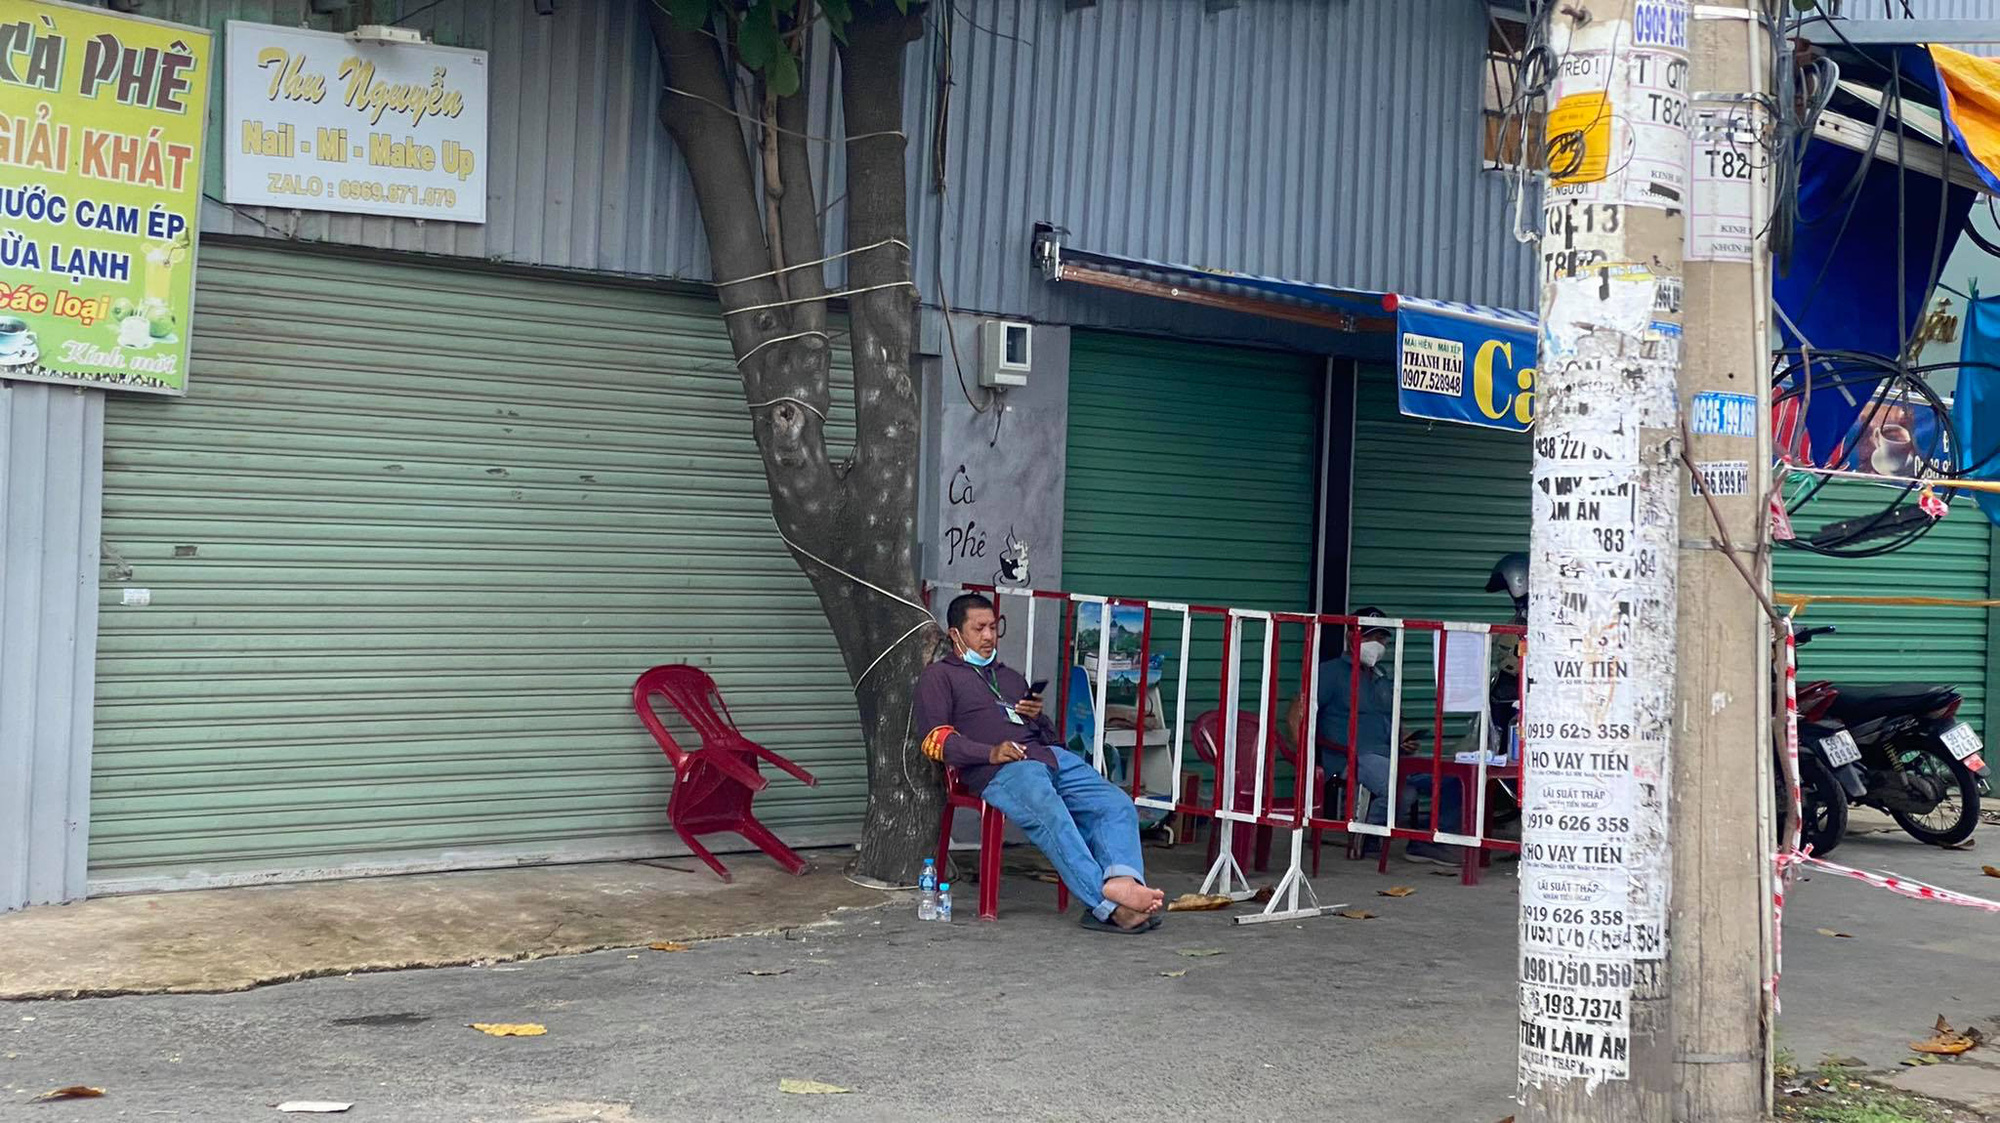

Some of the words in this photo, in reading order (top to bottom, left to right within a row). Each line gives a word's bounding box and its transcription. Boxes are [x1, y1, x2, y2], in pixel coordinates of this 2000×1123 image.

[0, 15, 66, 93] CÀ
[79, 33, 196, 114] PHÊ
[257, 47, 326, 104] Thu
[338, 56, 463, 127] Nguyễn
[81, 127, 194, 191] KHÁT
[242, 120, 294, 157] Nail
[317, 127, 347, 163] Mi
[369, 133, 436, 171] Make
[442, 140, 475, 181] Up
[267, 173, 323, 196] ZALO
[0, 186, 67, 223] ƯỚC
[75, 200, 139, 235] CAM
[147, 204, 185, 240] ÉP
[0, 231, 40, 271] ỪA
[51, 245, 129, 283] LẠNH
[53, 290, 111, 326] loại
[1404, 351, 1440, 369] THANH
[1402, 368, 1461, 394] 0907.528948
[949, 464, 975, 505] Cà
[945, 521, 987, 565] Phê
[1554, 660, 1584, 678] VAY
[1597, 723, 1630, 740] 358
[1553, 752, 1585, 770] VAY
[1558, 815, 1591, 832] 626
[1596, 817, 1630, 833] 358
[1553, 907, 1584, 925] 626
[1590, 910, 1623, 926] 358
[1551, 1025, 1594, 1057] LÀM
